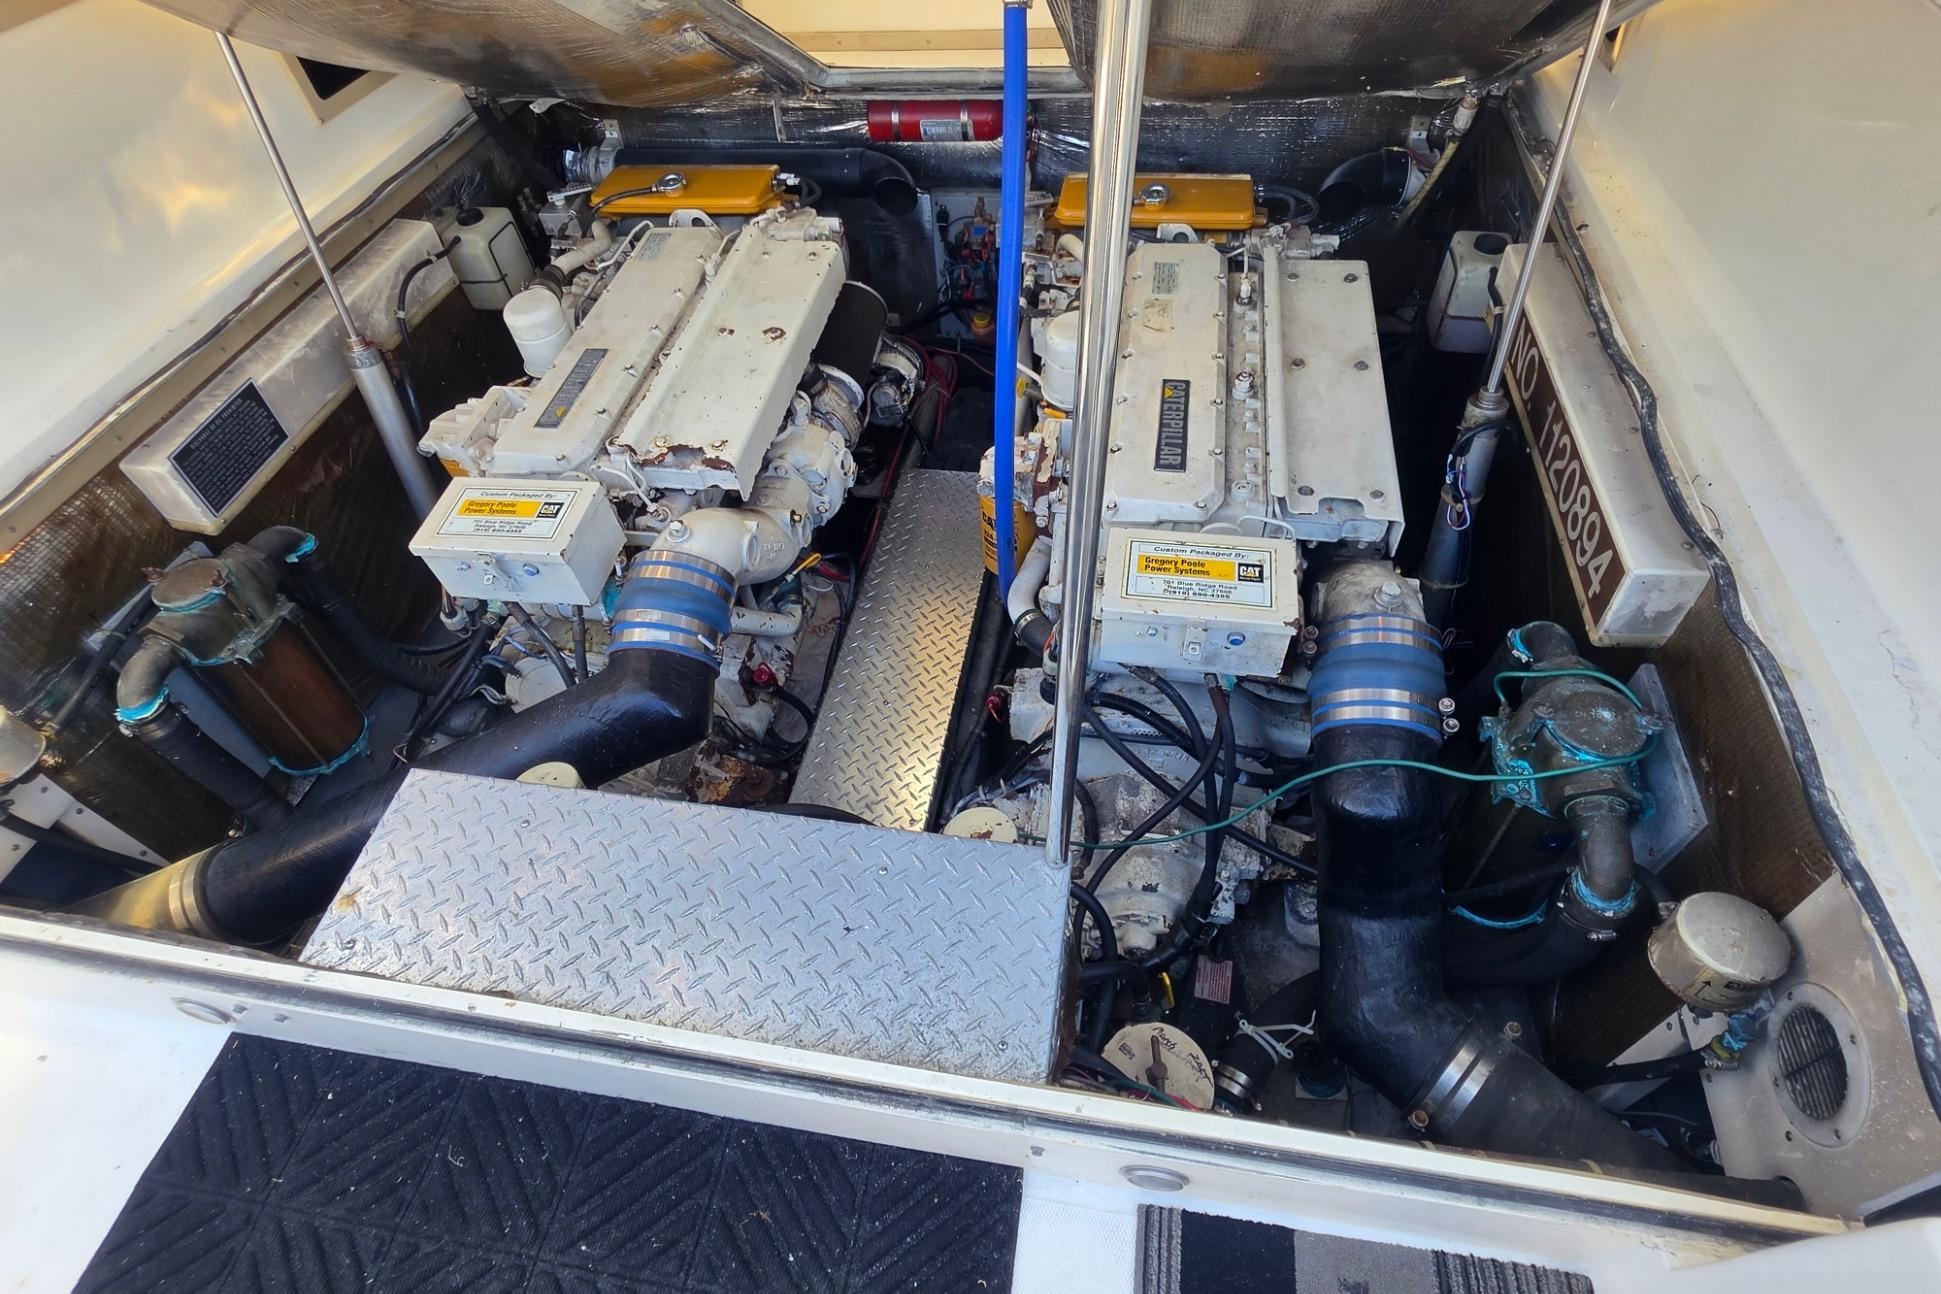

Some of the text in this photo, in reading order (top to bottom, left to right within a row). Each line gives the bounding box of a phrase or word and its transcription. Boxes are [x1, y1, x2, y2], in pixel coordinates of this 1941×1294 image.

[1160, 382, 1186, 465] CATERPILLAR
[467, 500, 495, 508] Gregory
[1539, 400, 1613, 599] 1120894
[487, 506, 517, 516] Systems
[540, 504, 561, 514] CAT
[1153, 546, 1250, 560] Custom Packaged By:
[1145, 556, 1206, 568] Gregory Poole
[1144, 565, 1210, 576] Power Systems
[1239, 566, 1261, 577] CAT
[1195, 582, 1217, 590] Ridge
